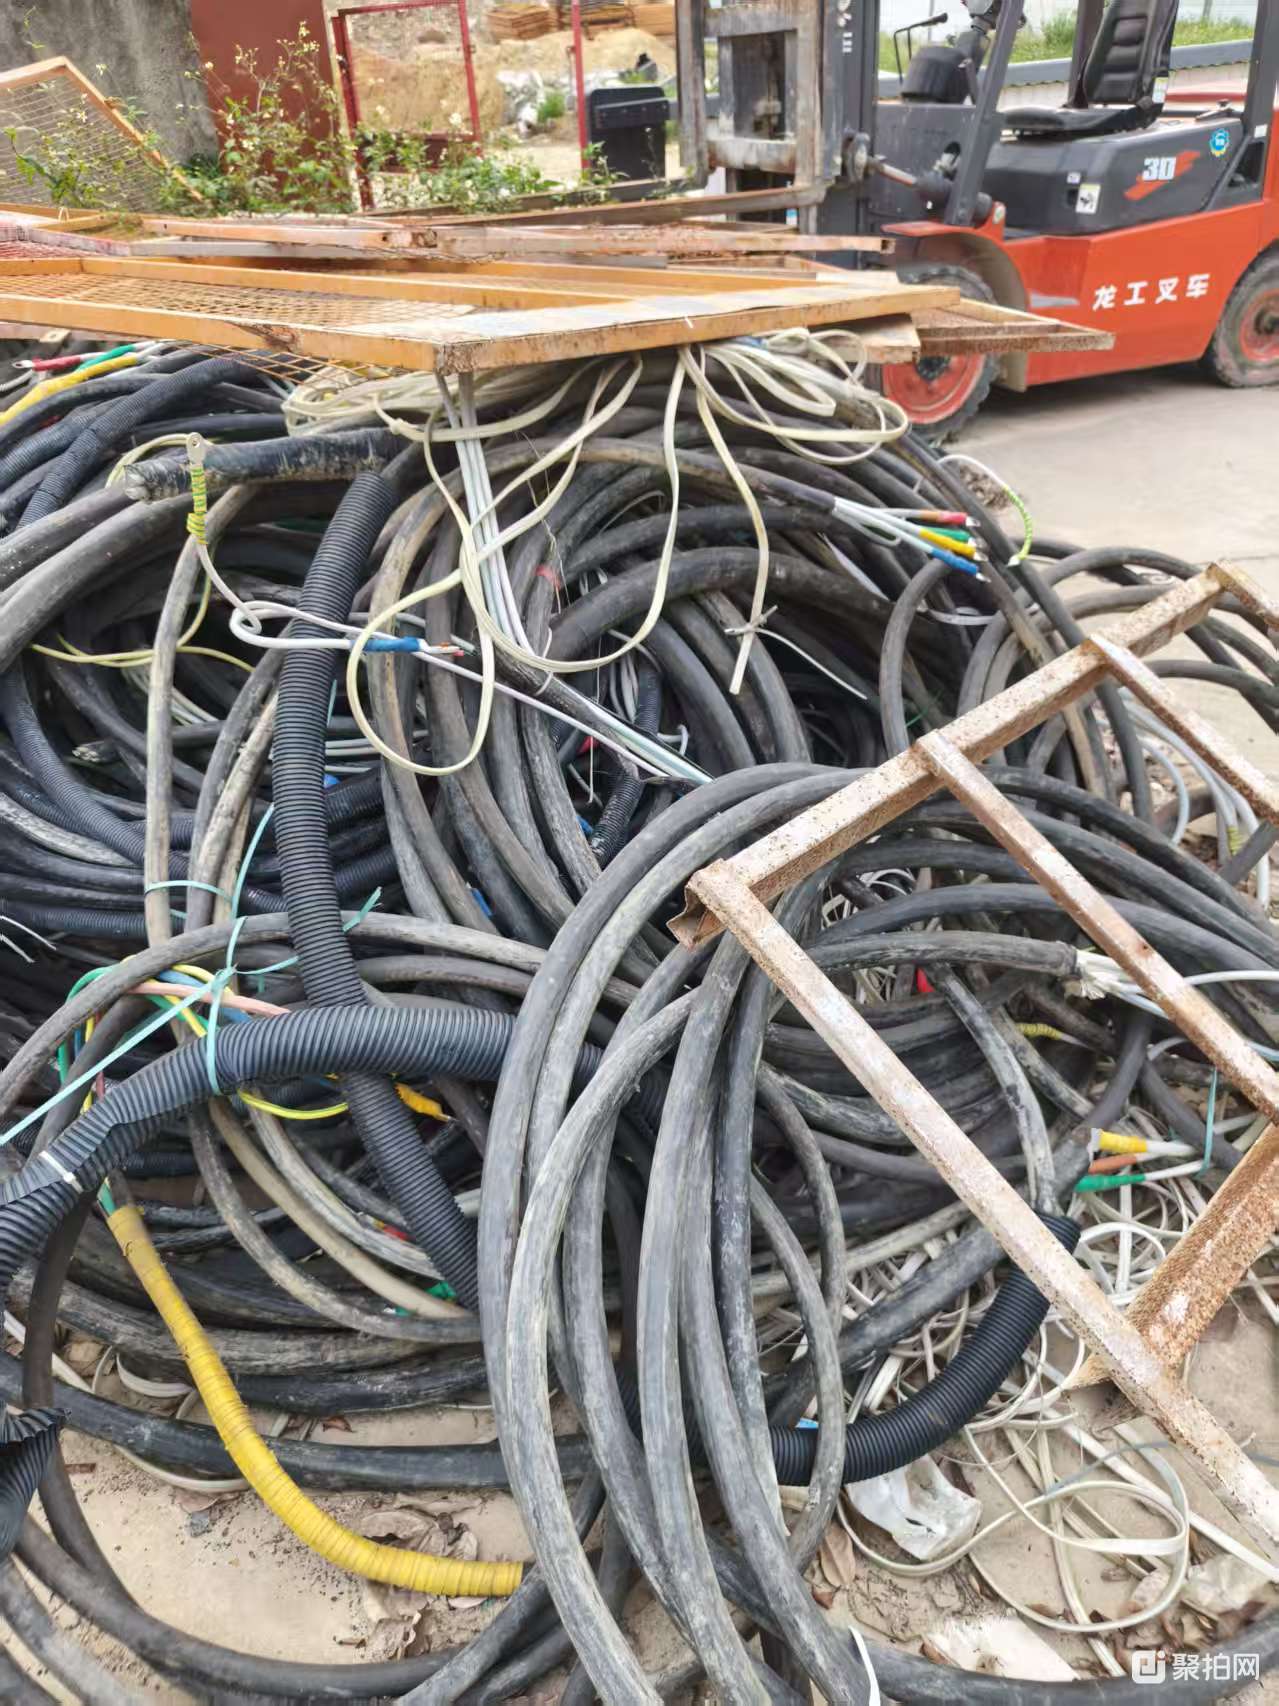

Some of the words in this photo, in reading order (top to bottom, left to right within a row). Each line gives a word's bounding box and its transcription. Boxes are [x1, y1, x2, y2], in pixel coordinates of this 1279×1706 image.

[1142, 156, 1177, 181] 30
[1092, 272, 1211, 312] 龙工叉车
